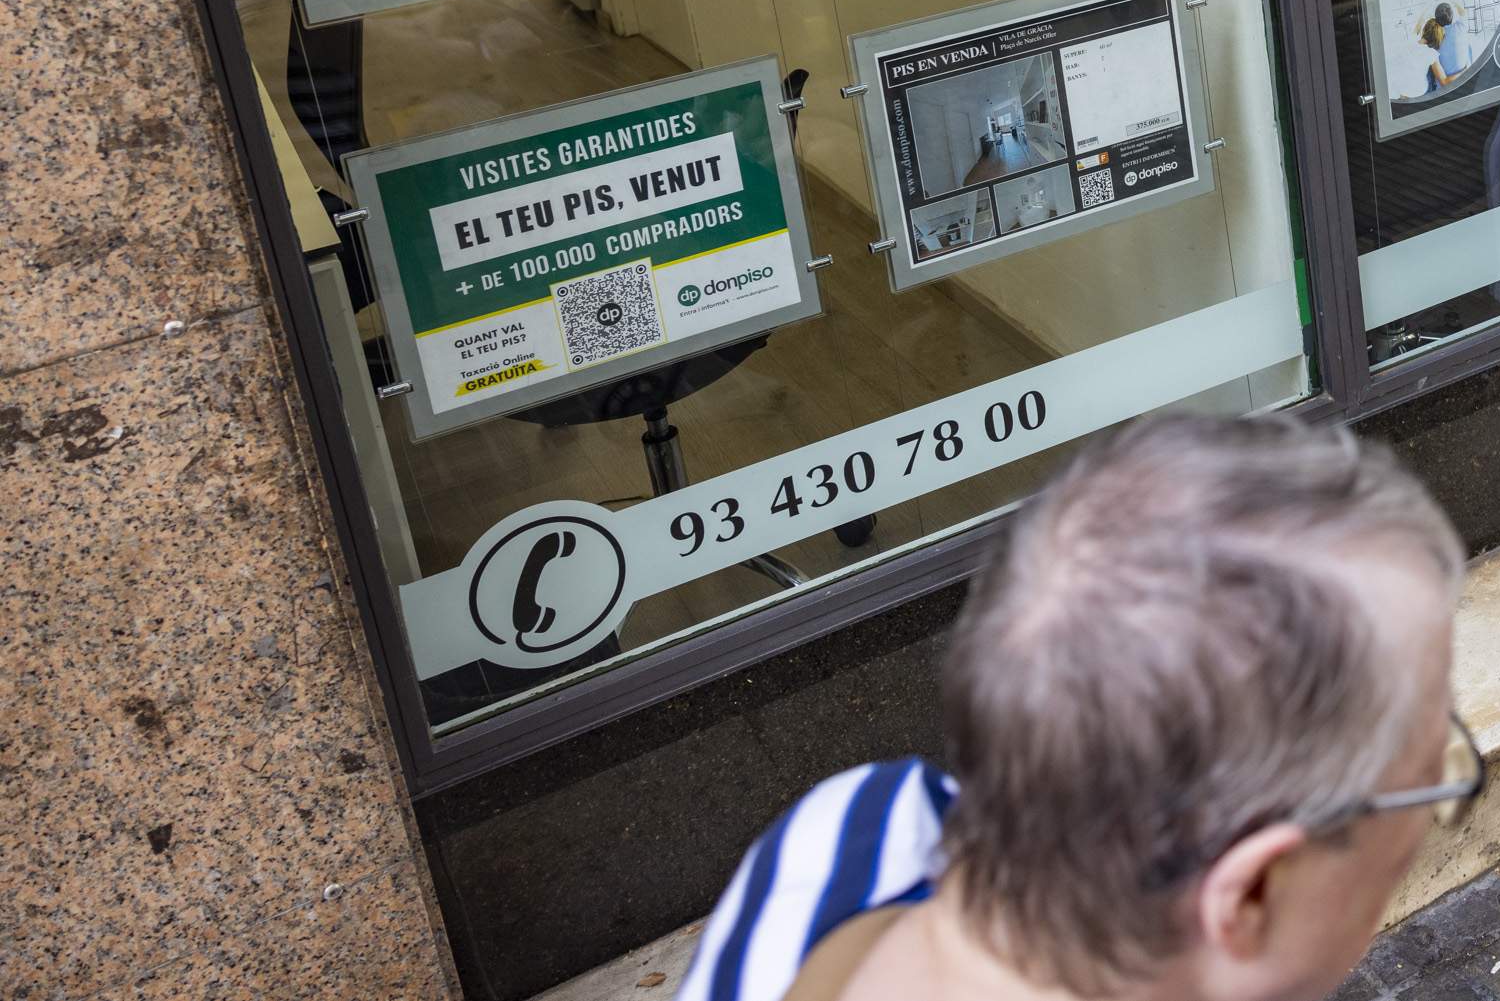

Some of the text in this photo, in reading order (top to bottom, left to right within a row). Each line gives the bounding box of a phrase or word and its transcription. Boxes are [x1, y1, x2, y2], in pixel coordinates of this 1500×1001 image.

[999, 24, 1053, 42] VILA DE GRÀCIA
[1000, 41, 1015, 51] Plaça
[892, 44, 989, 78] PIS EN VENDA
[1136, 118, 1161, 130] 375.000
[459, 110, 697, 191] VISITES GARANTIDES
[893, 98, 916, 196] www.donpiso.com
[1139, 161, 1178, 180] donpiso
[454, 154, 723, 251] EL TEU PIS, VENUT
[455, 200, 744, 295] + DE 100.000 COMPRADORS
[680, 265, 774, 304] dp donpiso
[599, 305, 621, 323] dp
[680, 308, 697, 318] Entra
[454, 322, 525, 349] QUANT VAL
[461, 333, 527, 359] EL TEU PIS?
[460, 350, 535, 380] Taxació Online
[465, 361, 538, 392] GRATUÏTA
[669, 388, 1048, 558] 93 430 78 00
